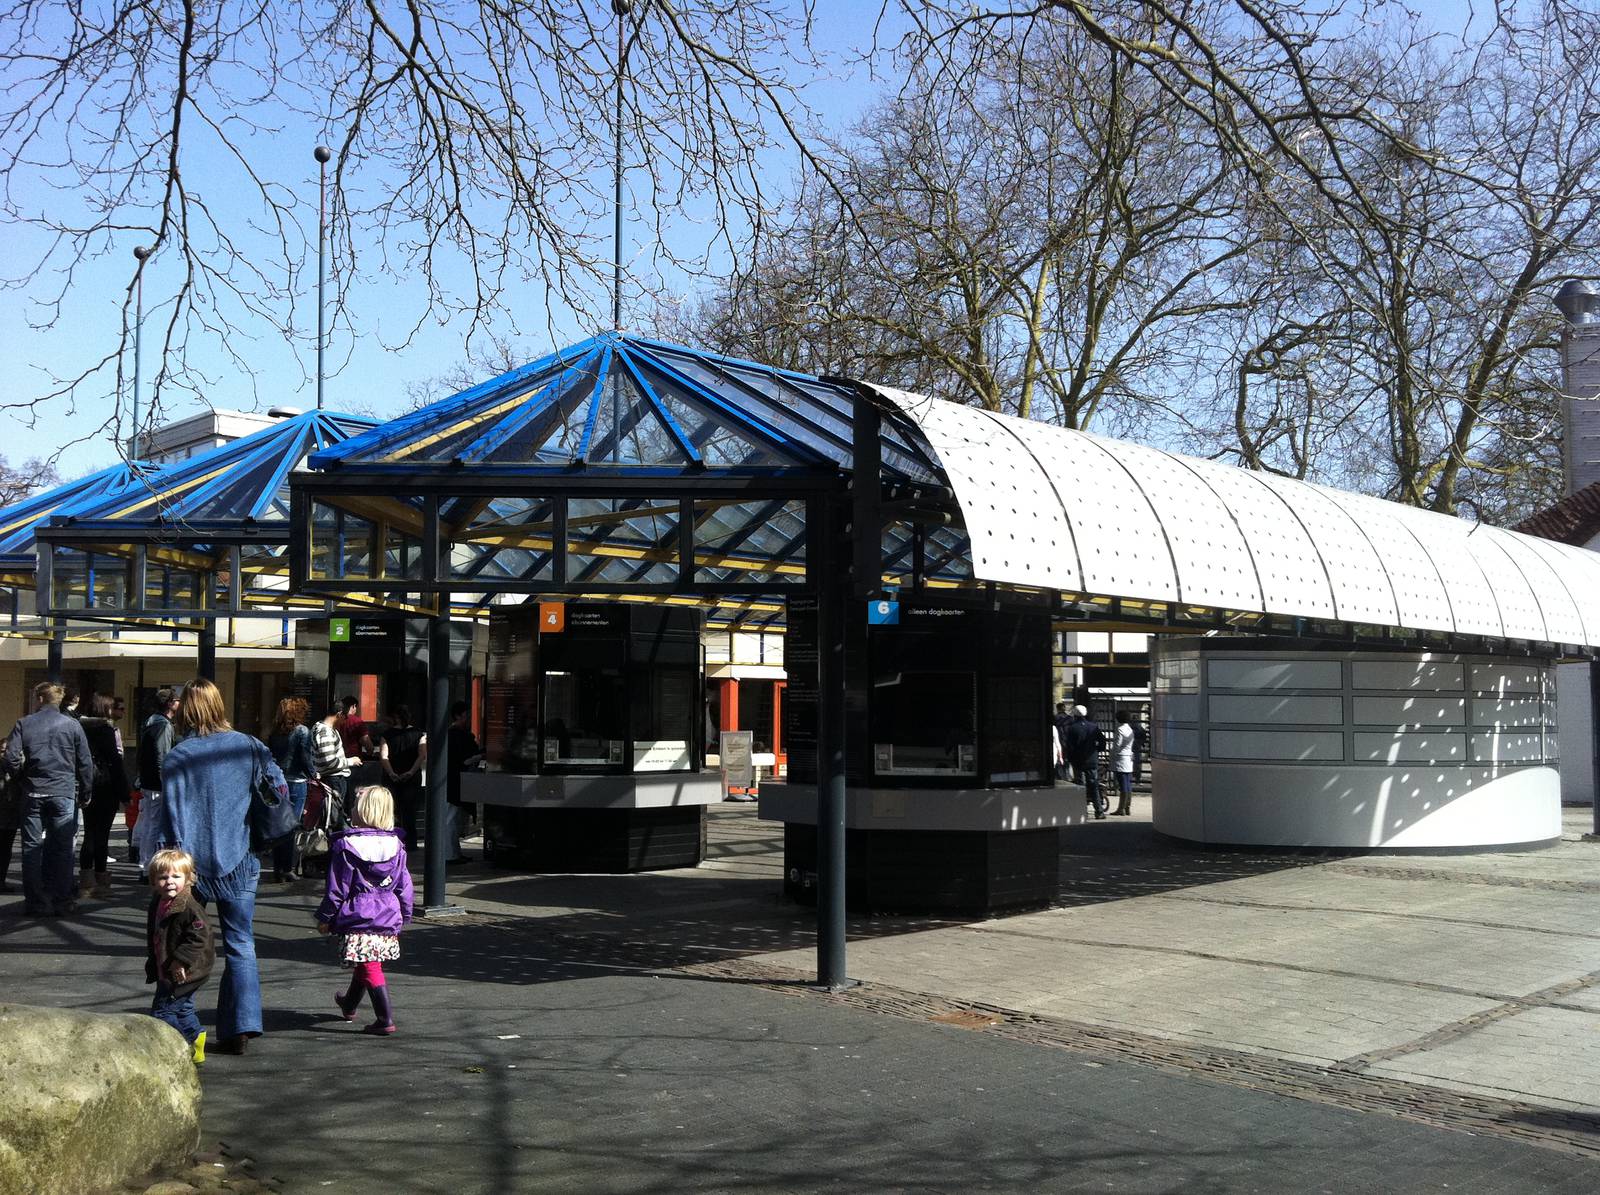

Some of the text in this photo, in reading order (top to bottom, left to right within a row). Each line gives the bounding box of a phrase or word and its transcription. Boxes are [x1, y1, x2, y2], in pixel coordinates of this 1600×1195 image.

[878, 601, 890, 615] 6
[547, 614, 557, 625] 4
[336, 626, 344, 636] 2
